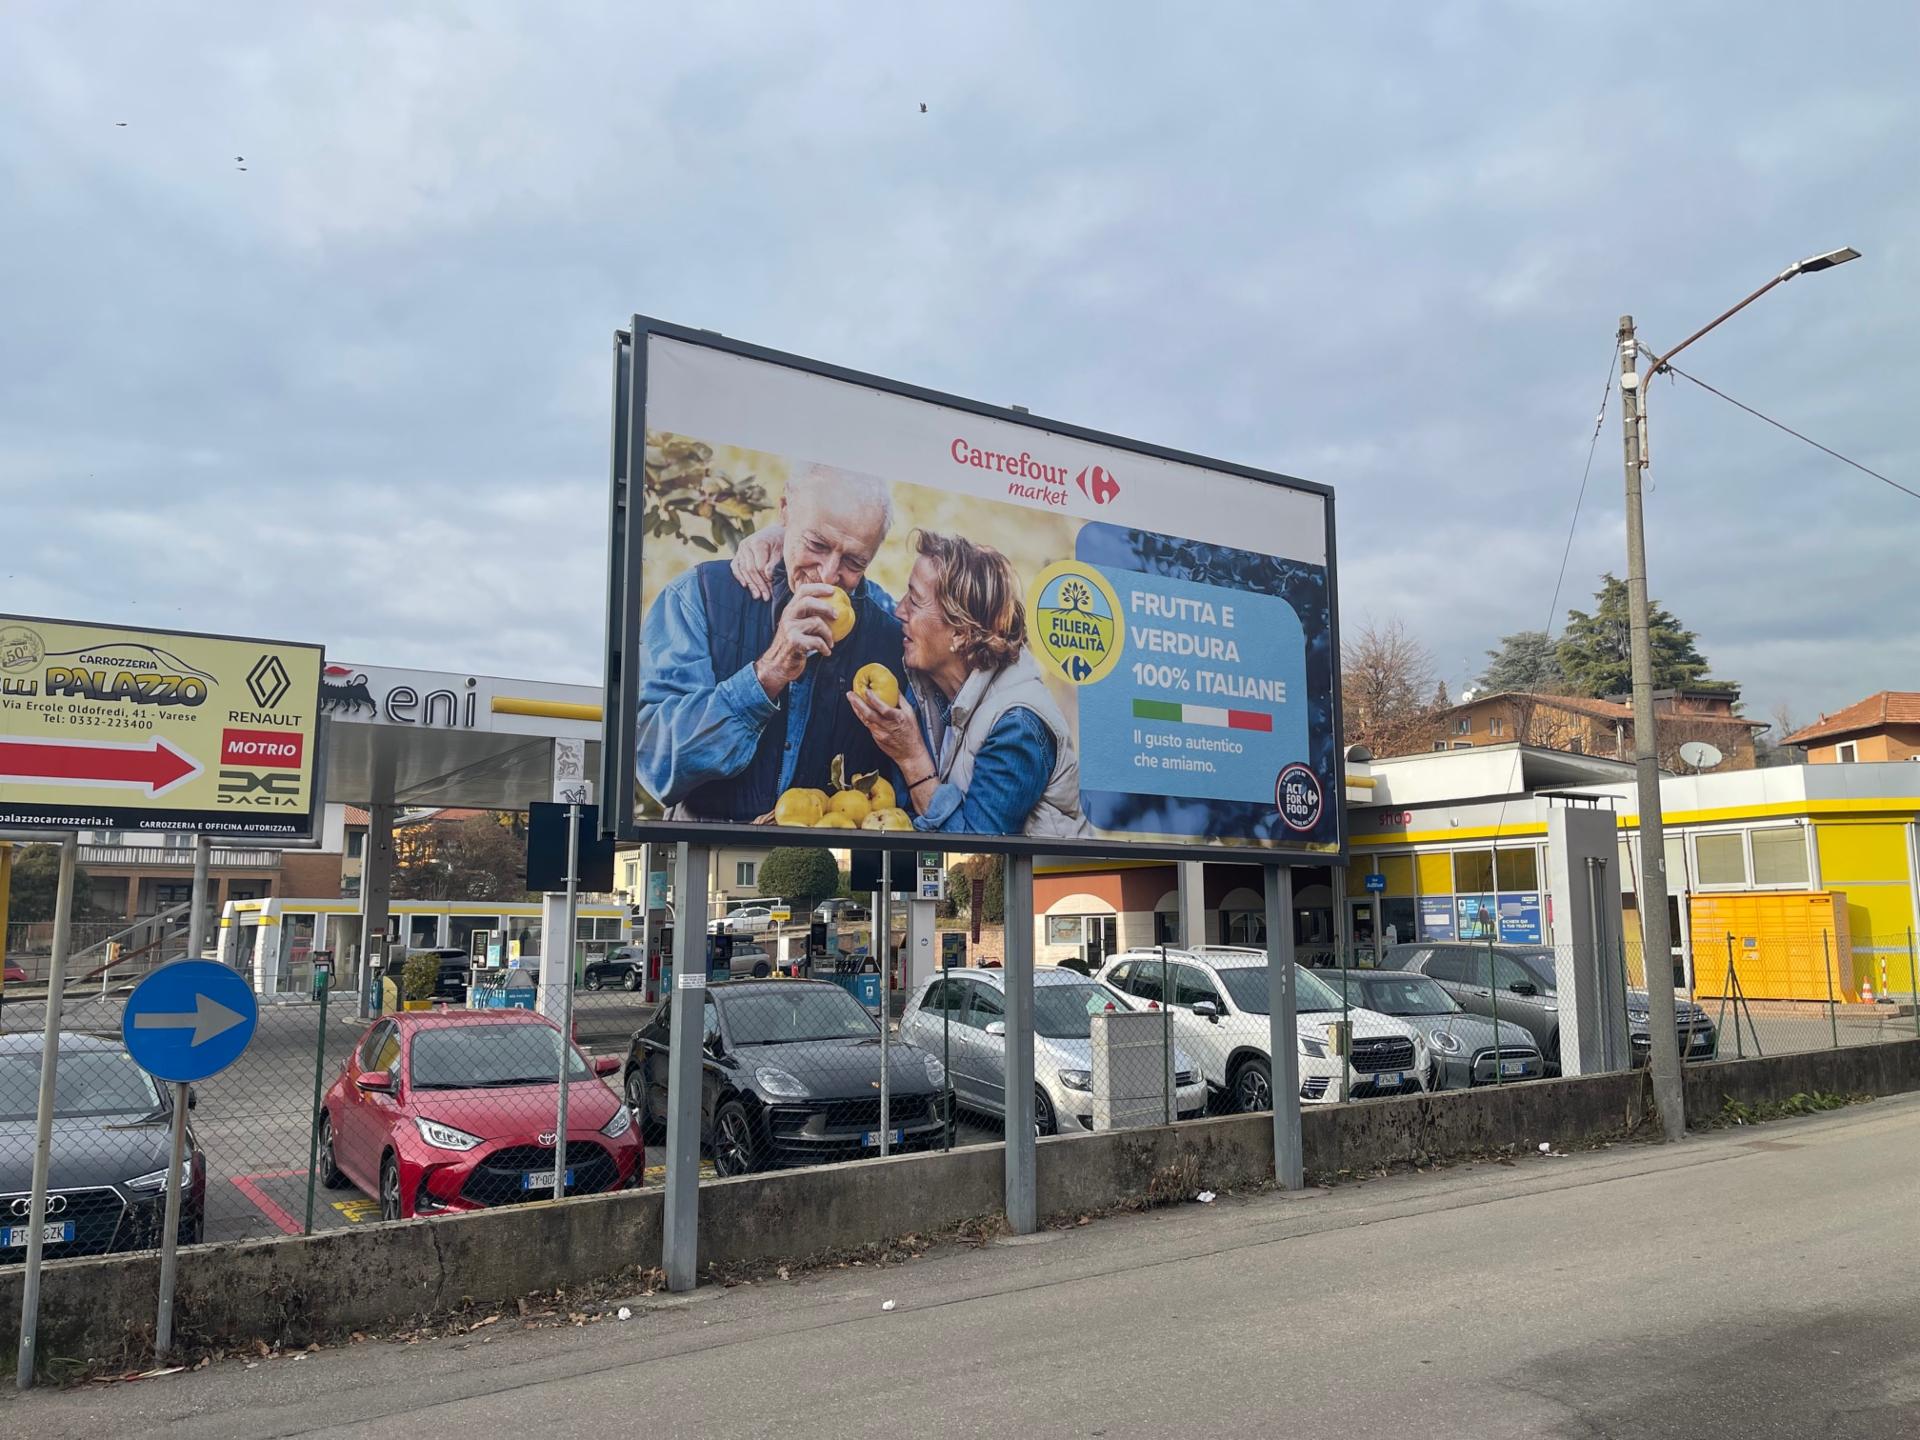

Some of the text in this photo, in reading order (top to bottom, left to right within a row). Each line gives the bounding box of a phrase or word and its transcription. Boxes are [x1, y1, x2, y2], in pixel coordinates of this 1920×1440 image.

[951, 438, 1068, 486] Carrefour
[1008, 481, 1068, 506] market
[1131, 590, 1234, 628] FRUTTA E
[1052, 617, 1100, 637] FILIERA
[1131, 626, 1241, 663] VERDURA
[79, 654, 158, 670] CARROZZERIA
[46, 667, 208, 706] PALAZZO
[1132, 662, 1287, 703] 100% ITALIANE
[3, 699, 21, 710] Via
[26, 701, 63, 712] Ercole
[68, 704, 128, 718] Oldofredi,
[132, 709, 146, 718] 41
[159, 711, 197, 721] Varese
[385, 676, 478, 727] eni
[43, 713, 153, 729] Tel: 0332-223400
[228, 711, 302, 726] RENAULT
[227, 741, 297, 756] MOTRIO
[1134, 729, 1243, 754] Il gusto autentico
[1134, 752, 1217, 773] che amiamo.
[1286, 783, 1302, 794] ACT
[217, 794, 298, 807] DACIA
[1286, 794, 1302, 805] FOR
[1286, 803, 1309, 815] FOOD
[139, 820, 196, 830] CARROZZERIA
[205, 822, 242, 831] OFFICINA
[244, 823, 296, 833] AUTORIZZATA
[1379, 809, 1412, 827] shop
